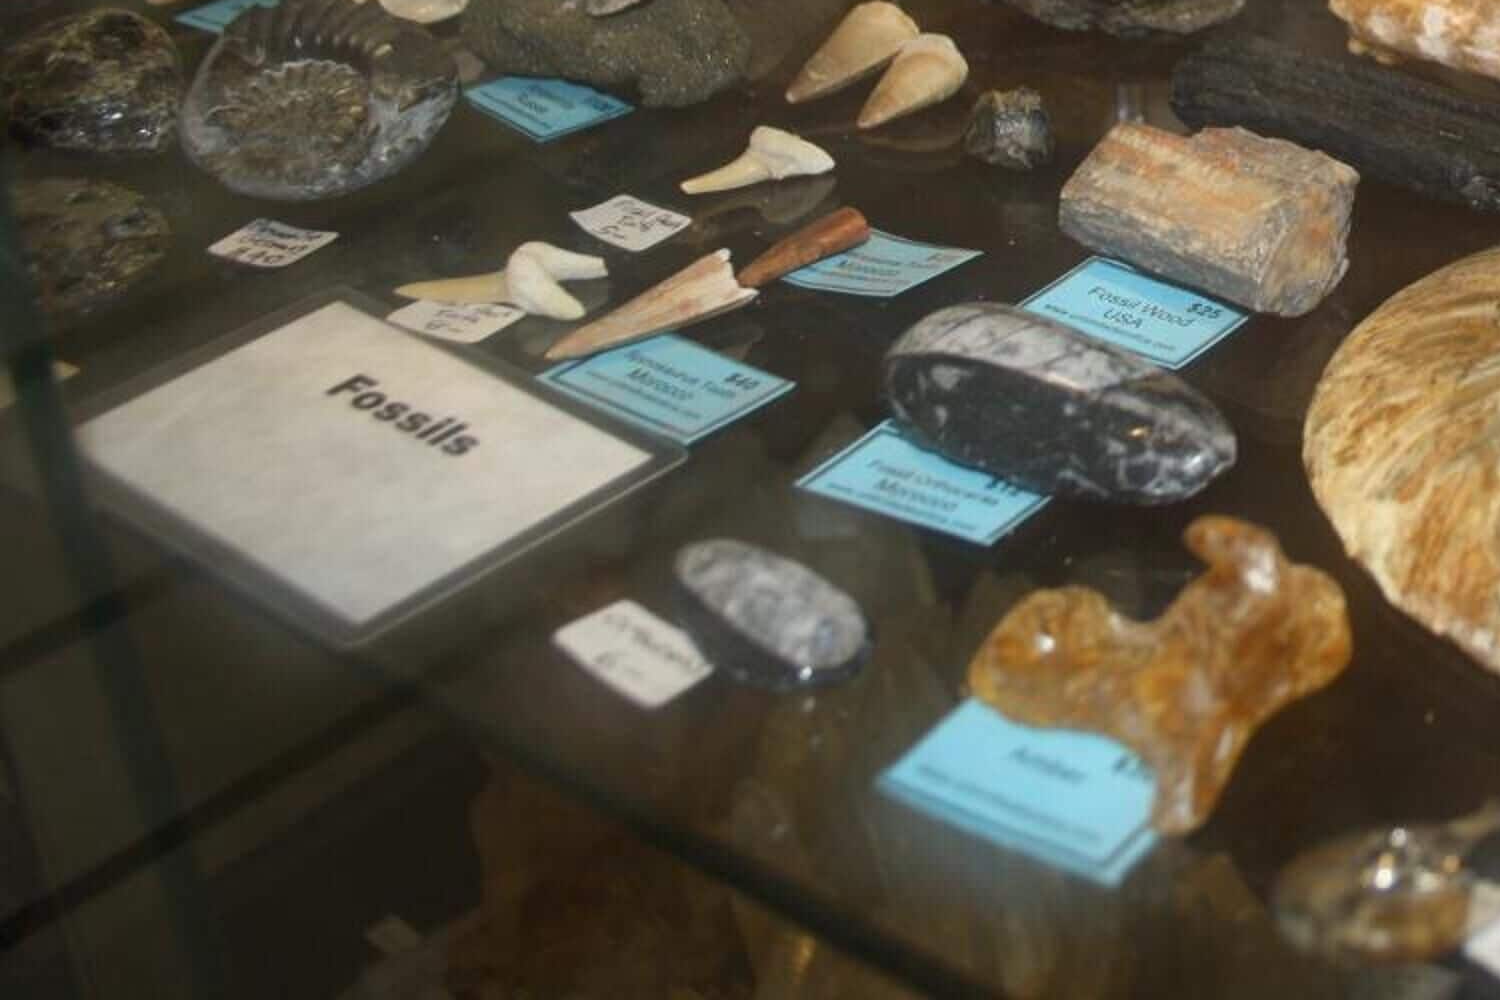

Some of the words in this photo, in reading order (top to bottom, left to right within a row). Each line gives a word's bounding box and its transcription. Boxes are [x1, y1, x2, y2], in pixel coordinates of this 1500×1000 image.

[1088, 285, 1141, 309] Fossil
[1141, 300, 1197, 328] Wood
[1103, 308, 1145, 330] USA
[1186, 302, 1222, 320] $25
[325, 372, 482, 457] Fossils
